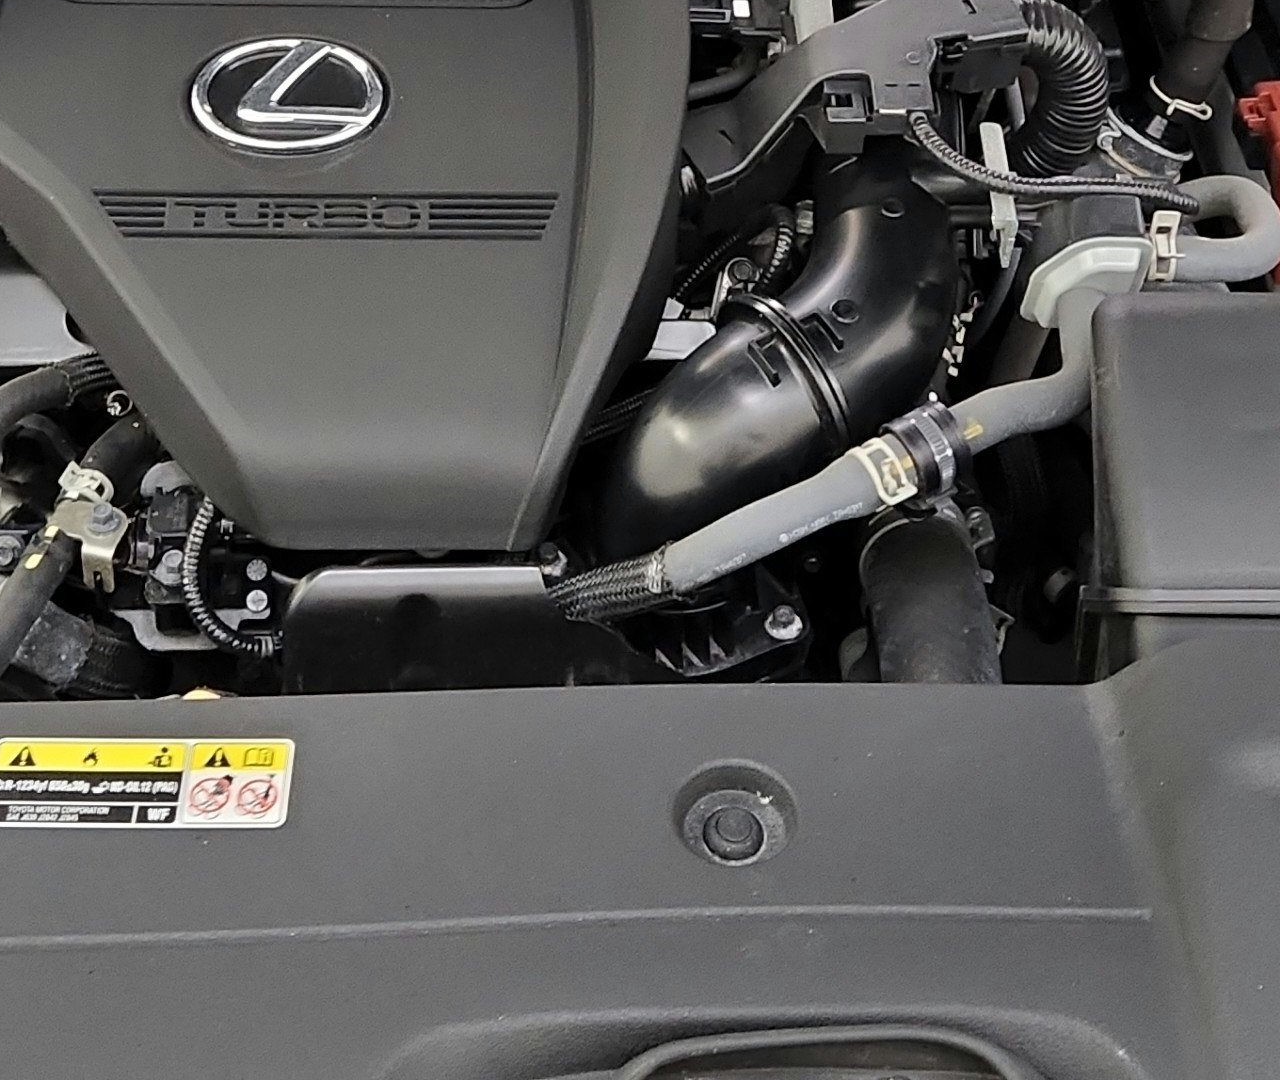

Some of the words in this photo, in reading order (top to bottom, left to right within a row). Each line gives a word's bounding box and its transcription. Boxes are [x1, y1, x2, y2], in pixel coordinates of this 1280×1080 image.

[173, 201, 423, 230] TURBO
[35, 805, 61, 814] MOTOR
[61, 806, 110, 815] CORPORATION
